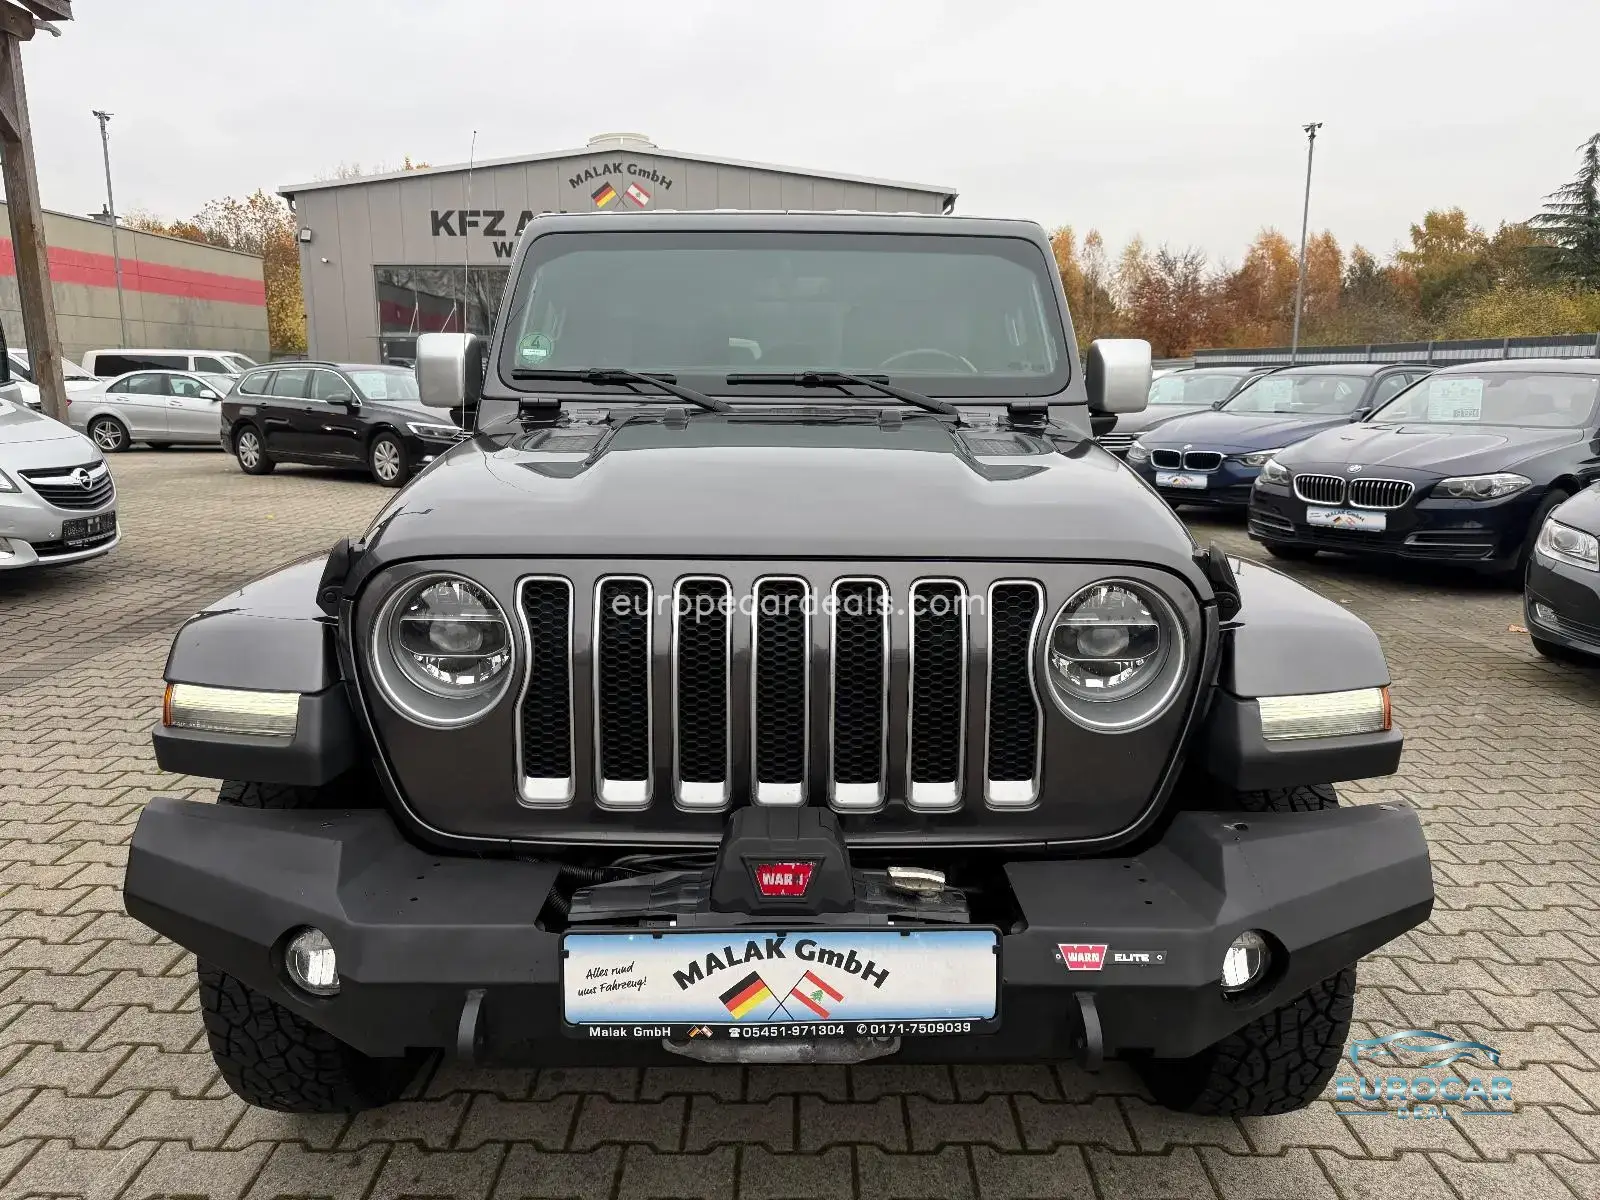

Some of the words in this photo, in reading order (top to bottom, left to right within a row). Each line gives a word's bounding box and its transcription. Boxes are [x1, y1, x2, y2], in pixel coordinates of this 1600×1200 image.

[568, 162, 622, 189] MALAK
[626, 163, 673, 190] GmbH
[430, 210, 507, 237] KFZ
[530, 335, 541, 349] 4
[672, 937, 786, 991] MALAK
[794, 938, 890, 989] GmbH
[1067, 952, 1100, 962] WARN
[1114, 953, 1150, 962] ELITE
[585, 966, 609, 980] Alles
[611, 960, 635, 976] rund
[577, 986, 597, 997] ums
[600, 976, 647, 993] Fahrzeug!
[589, 1026, 628, 1037] Malak
[633, 1026, 671, 1037] GmbH
[743, 1024, 845, 1038] 05451-971304
[870, 1022, 972, 1036] 0171-7509039
